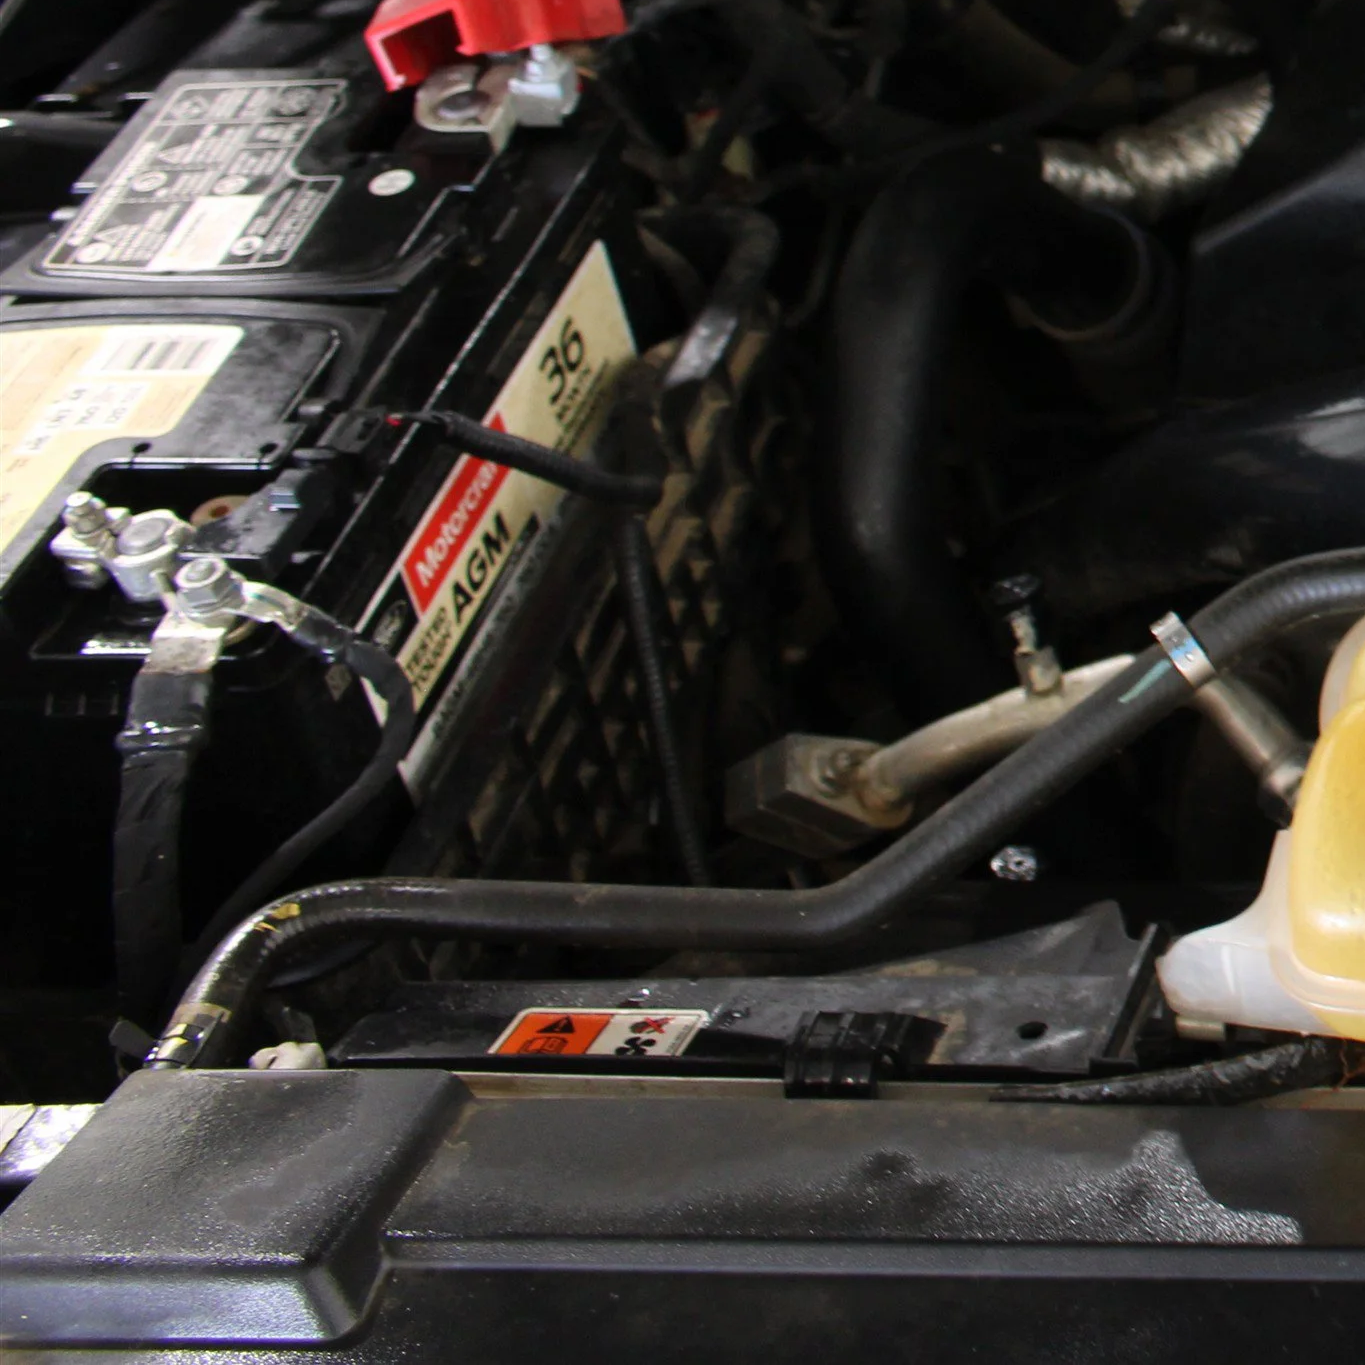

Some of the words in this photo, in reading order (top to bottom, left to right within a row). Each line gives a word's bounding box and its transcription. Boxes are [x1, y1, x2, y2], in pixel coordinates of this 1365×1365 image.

[539, 315, 584, 405] 36
[415, 459, 500, 588] Motorcra
[453, 511, 511, 625] AGM
